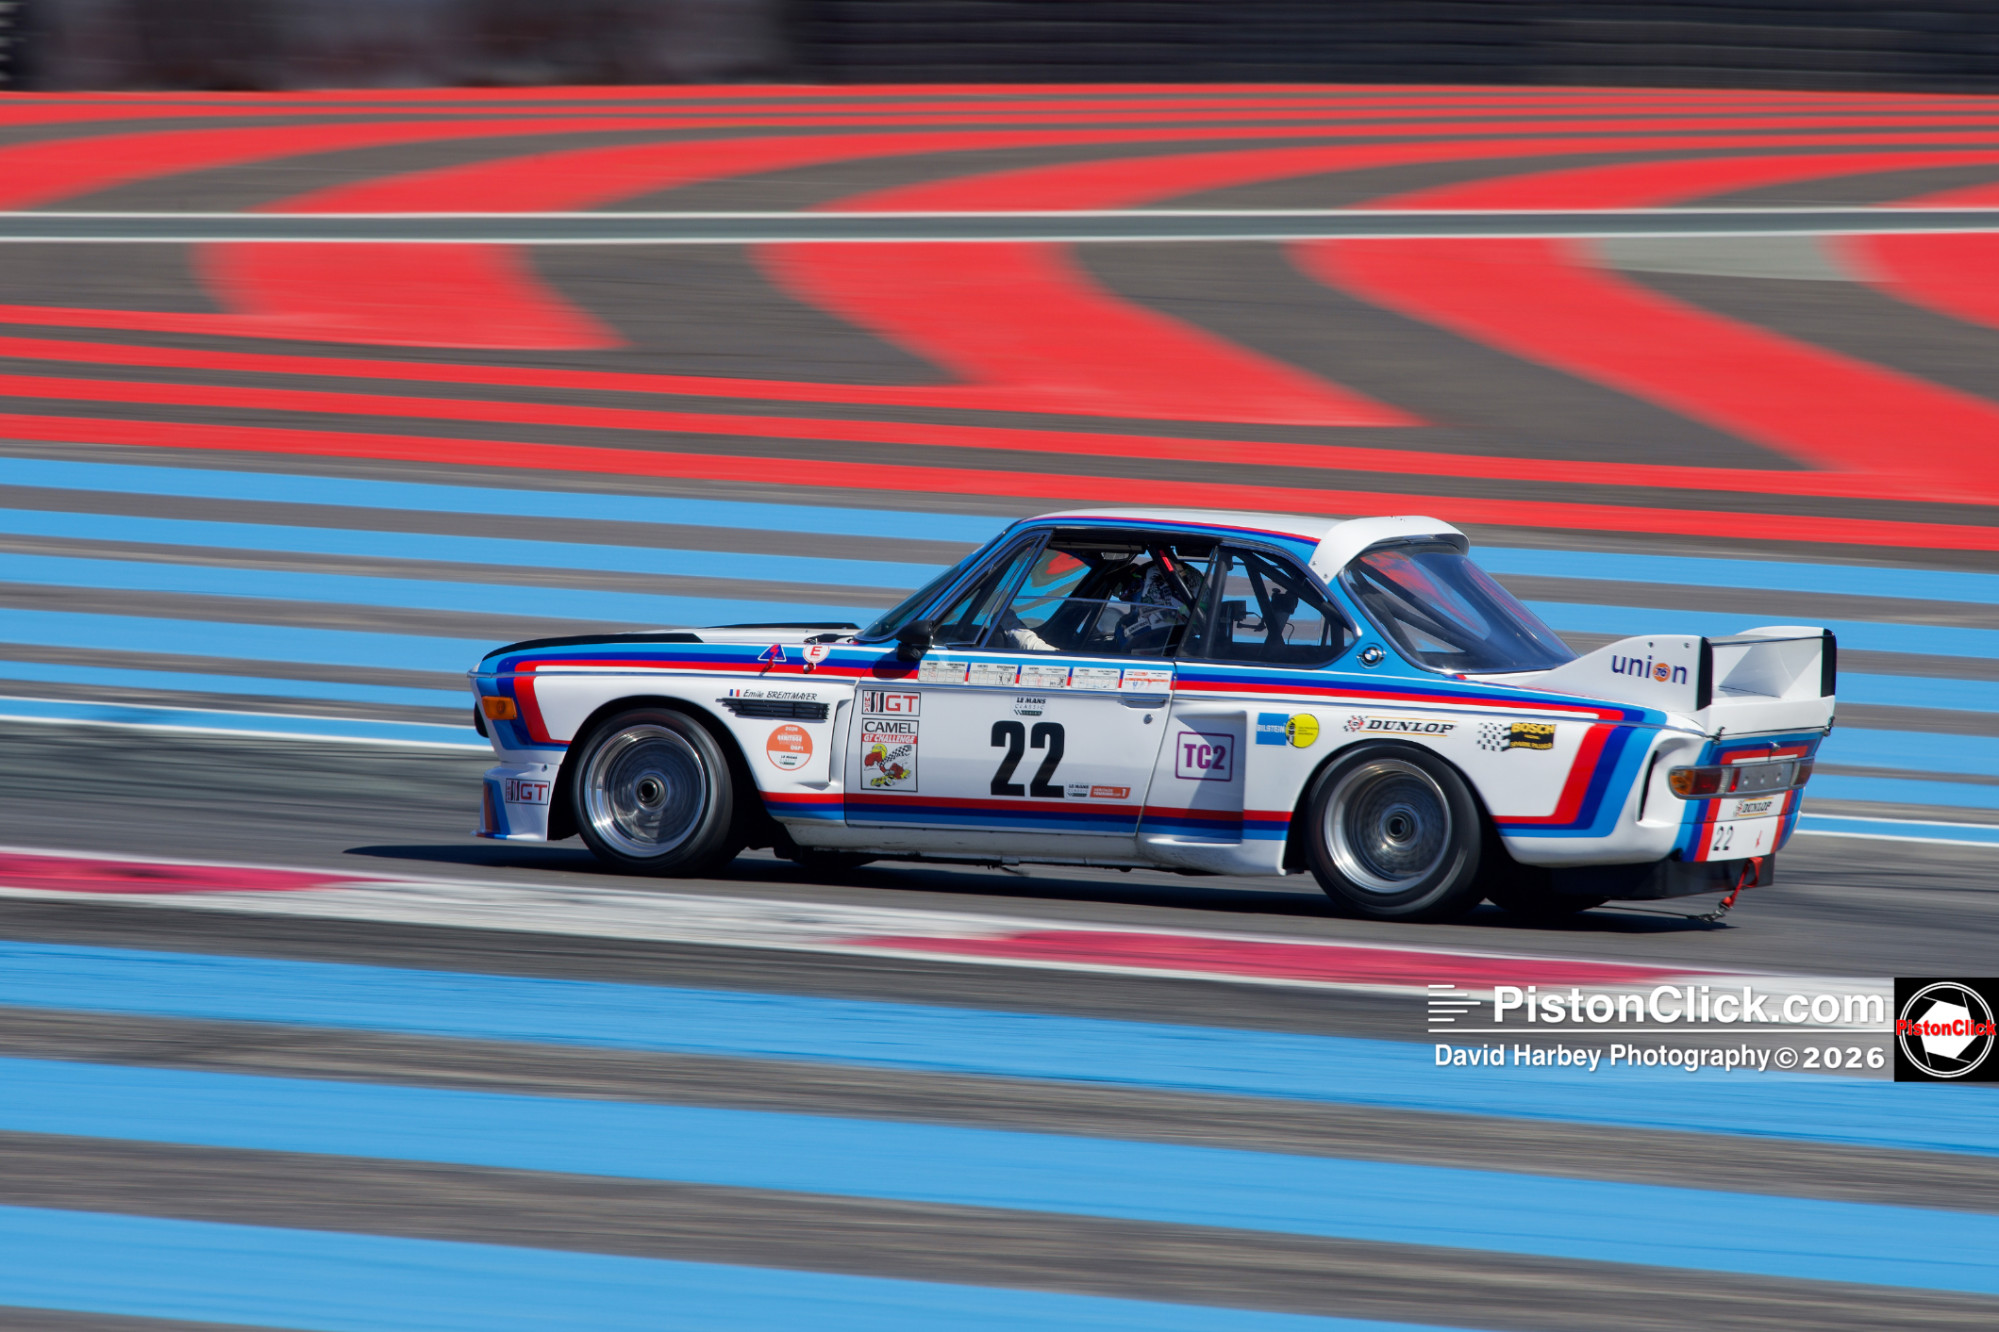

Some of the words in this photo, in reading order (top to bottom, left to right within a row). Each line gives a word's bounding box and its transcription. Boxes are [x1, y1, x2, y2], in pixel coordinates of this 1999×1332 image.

[810, 646, 823, 656] E
[885, 694, 919, 713] GT
[864, 721, 916, 734] CAMEL
[1366, 719, 1454, 733] DUNLOP
[1511, 723, 1556, 735] BOSCH
[874, 734, 915, 743] CHALLENGE
[990, 720, 1065, 798] 22
[1184, 743, 1226, 770] TC2
[520, 783, 547, 801] GT
[1742, 801, 1773, 813] DUNLOP
[1712, 825, 1734, 851] 22
